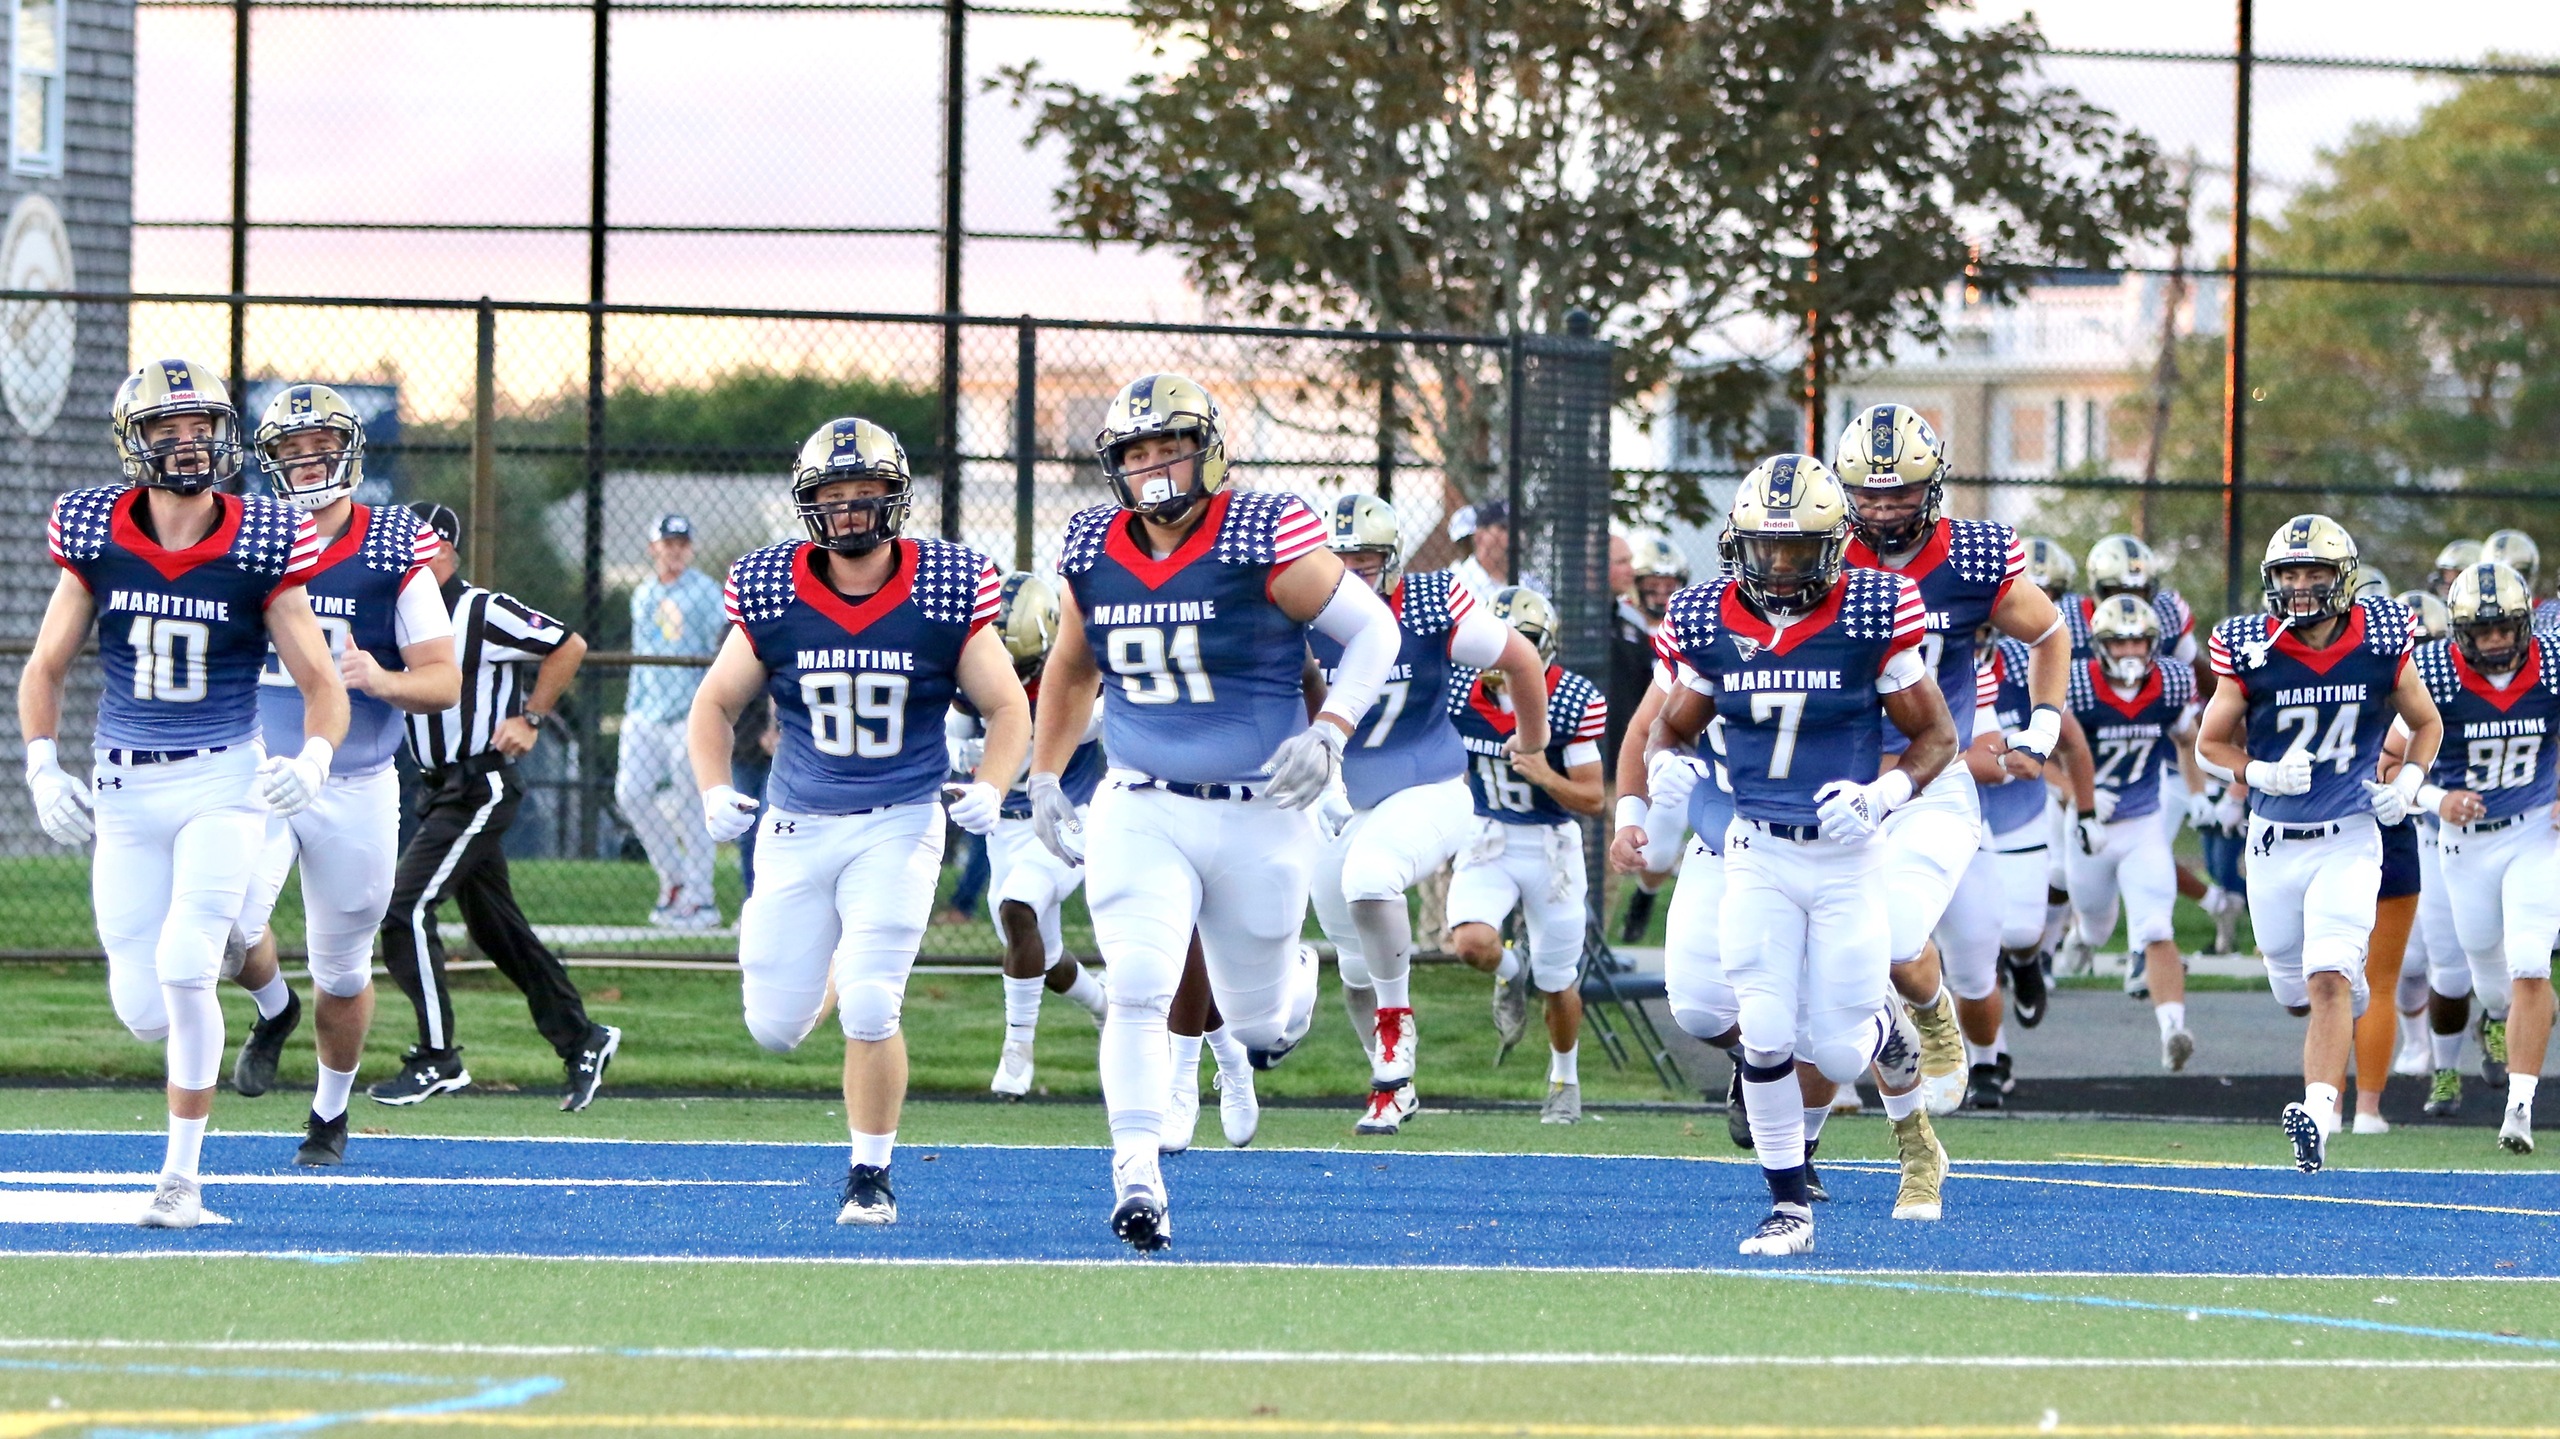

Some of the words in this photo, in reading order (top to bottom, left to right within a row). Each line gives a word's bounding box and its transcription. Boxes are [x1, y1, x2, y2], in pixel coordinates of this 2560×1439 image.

[170, 392, 196, 400] Riddell
[1868, 476, 1897, 484] Riddell
[1763, 520, 1794, 528] Riddell
[109, 590, 229, 622] MARITIME
[307, 594, 356, 616] TIME
[1094, 600, 1216, 625] MARITIME
[127, 615, 209, 702] 10
[797, 649, 914, 671] MARITIME
[1107, 625, 1216, 704] 91
[1723, 670, 1842, 692] MARITIME
[2275, 684, 2367, 706] MARITIME
[798, 672, 909, 759] 89
[1363, 681, 1410, 748] 7
[2464, 717, 2547, 738] MARITIME
[1463, 735, 1504, 757] MARI
[1750, 692, 1808, 779] 7
[2276, 703, 2360, 774] 24
[2094, 738, 2157, 786] 27
[2464, 735, 2543, 791] 98
[1477, 756, 1534, 813] 16
